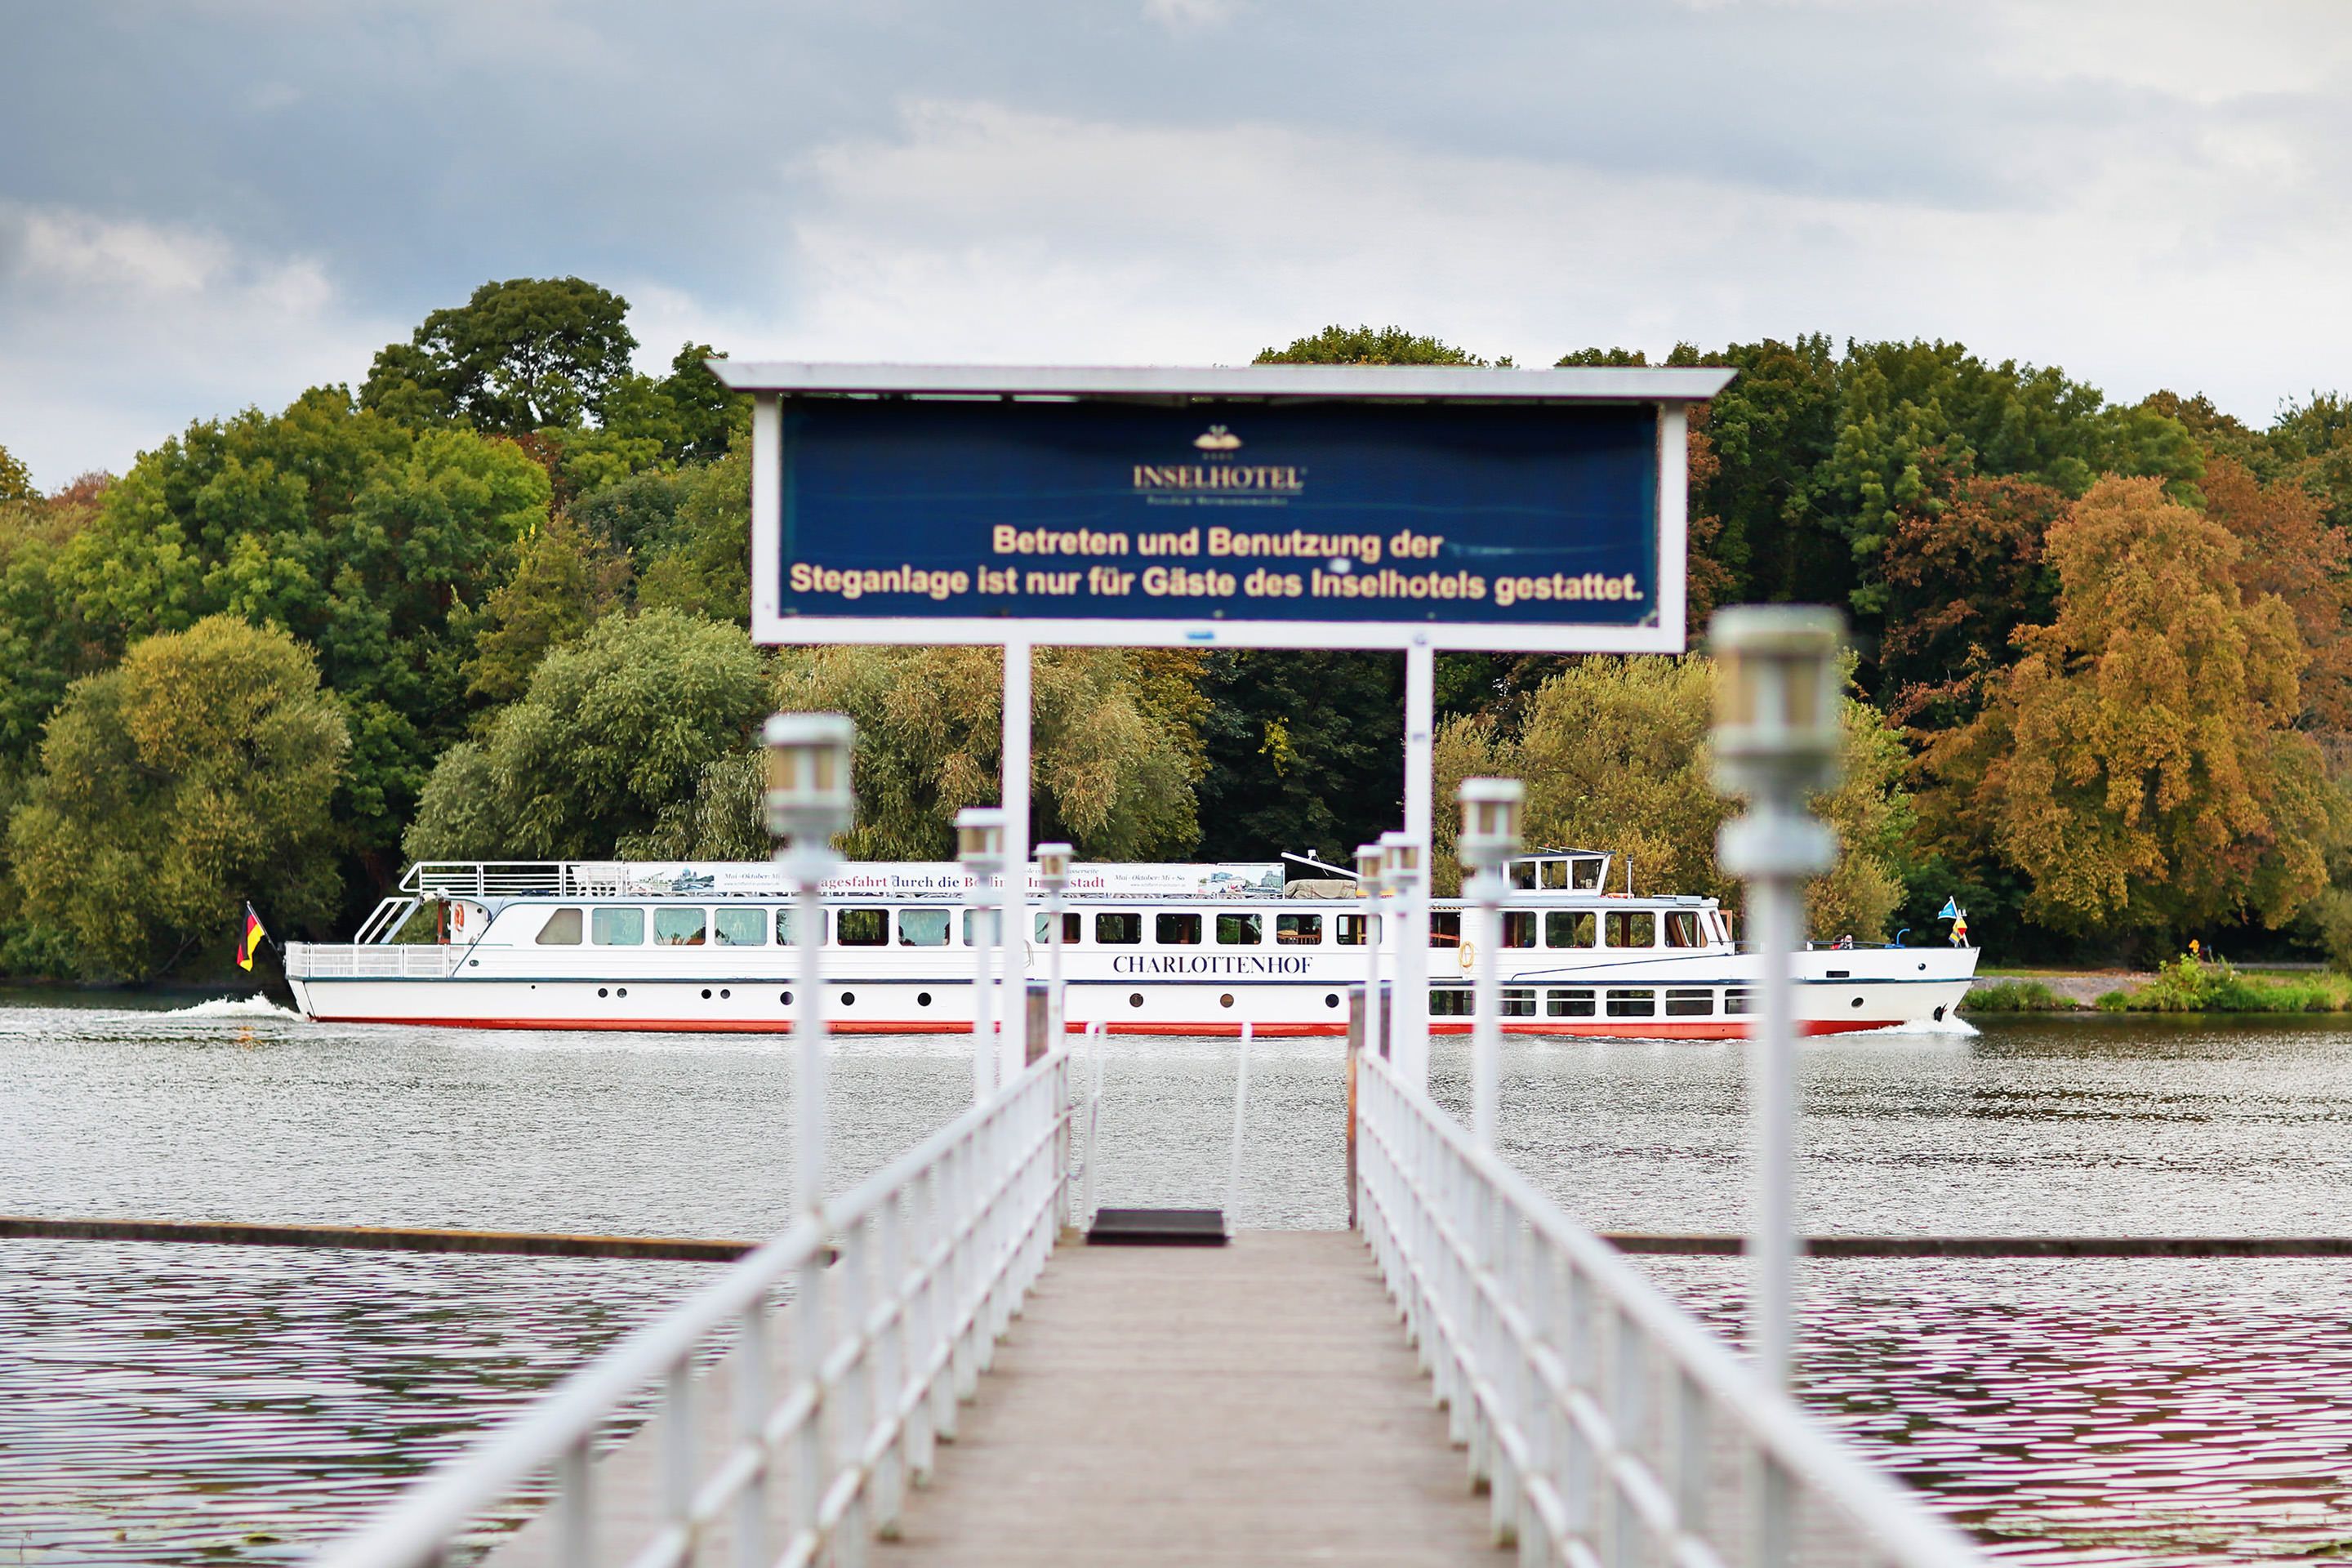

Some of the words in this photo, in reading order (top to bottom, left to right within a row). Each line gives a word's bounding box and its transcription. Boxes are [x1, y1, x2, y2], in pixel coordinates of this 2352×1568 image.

[1133, 465, 1304, 489] INSELHOTEL
[993, 525, 1129, 555] Betreten
[1138, 527, 1200, 556] und
[1208, 527, 1381, 564] Benutzung
[1389, 529, 1444, 558] der
[790, 563, 969, 599] Steganlage
[978, 564, 1018, 594] ist
[1026, 572, 1082, 595] nur
[1088, 566, 1136, 595] für
[1142, 566, 1237, 597] Gäste
[1244, 568, 1303, 597] des
[1312, 568, 1486, 599] Inselhotels
[1494, 572, 1644, 606] gestattet.
[821, 875, 888, 889] agesfahrt
[892, 875, 933, 888] durch
[938, 876, 960, 888] die
[1112, 956, 1313, 973] CHARLOTTENHOF
